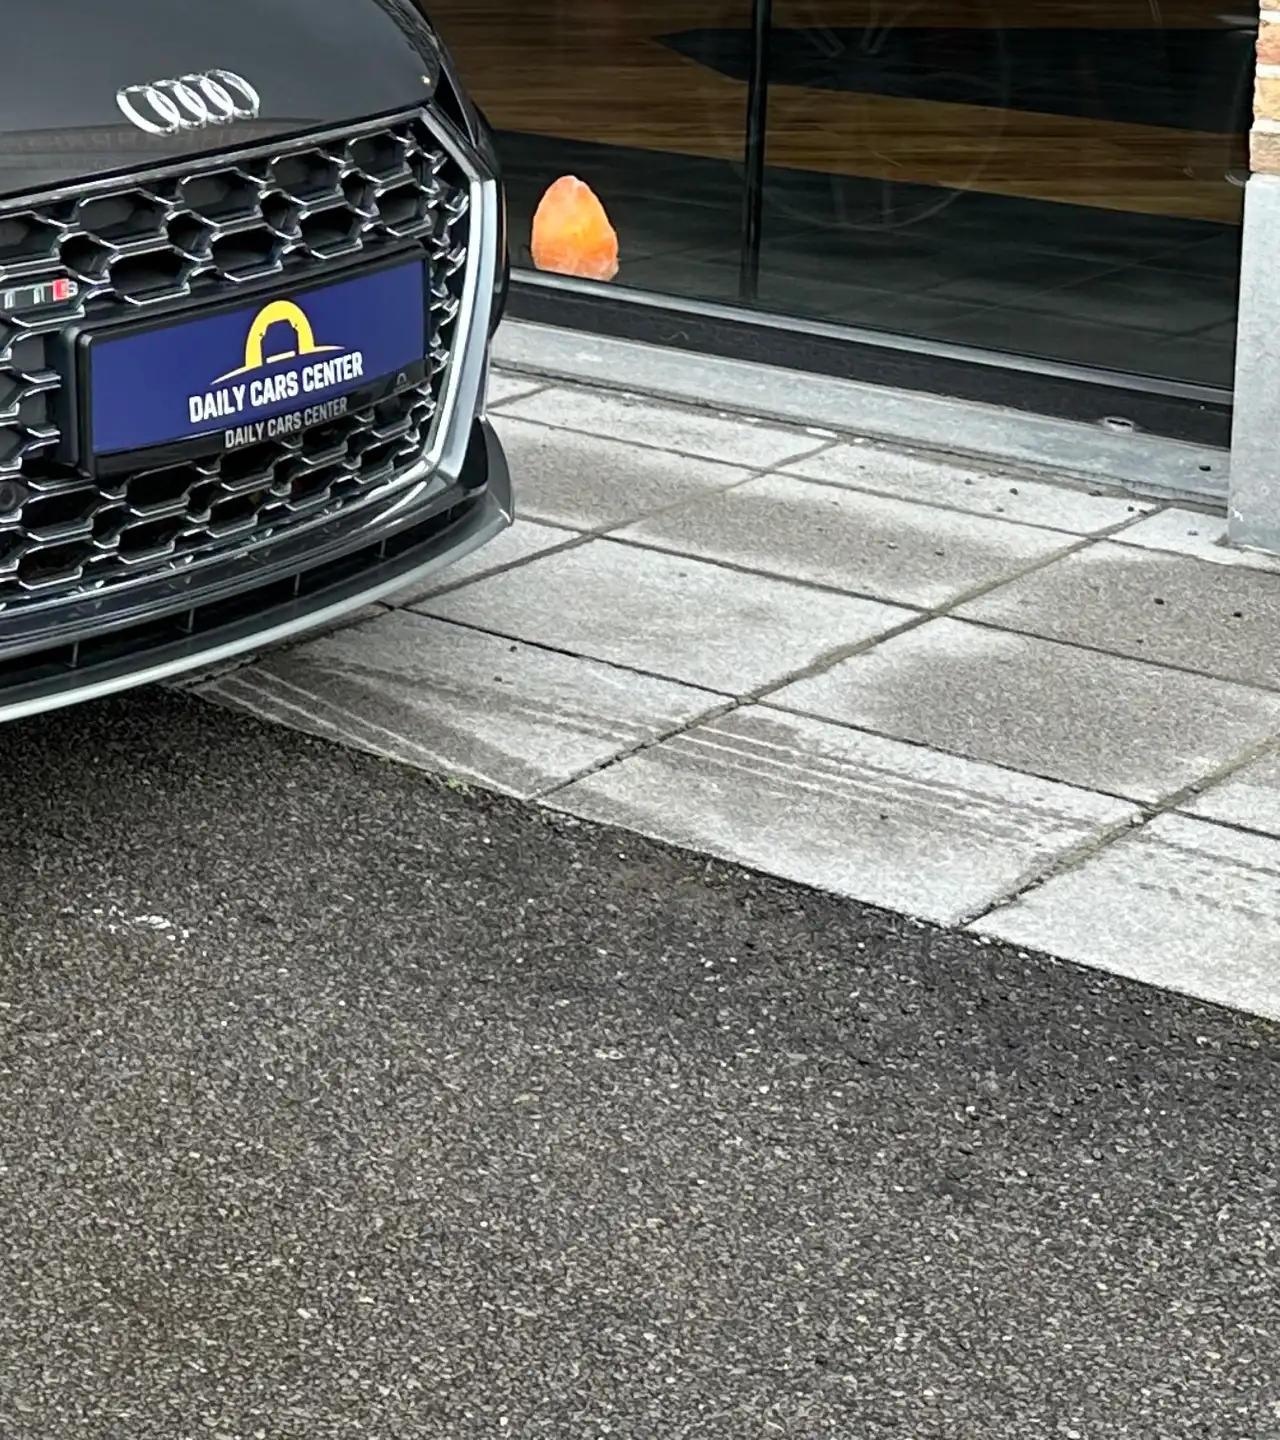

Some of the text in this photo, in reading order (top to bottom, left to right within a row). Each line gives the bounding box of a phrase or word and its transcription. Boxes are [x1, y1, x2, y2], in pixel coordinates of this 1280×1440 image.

[189, 351, 364, 424] DAILY CARS CENTER
[224, 396, 348, 449] DAILY CARS CENTER
